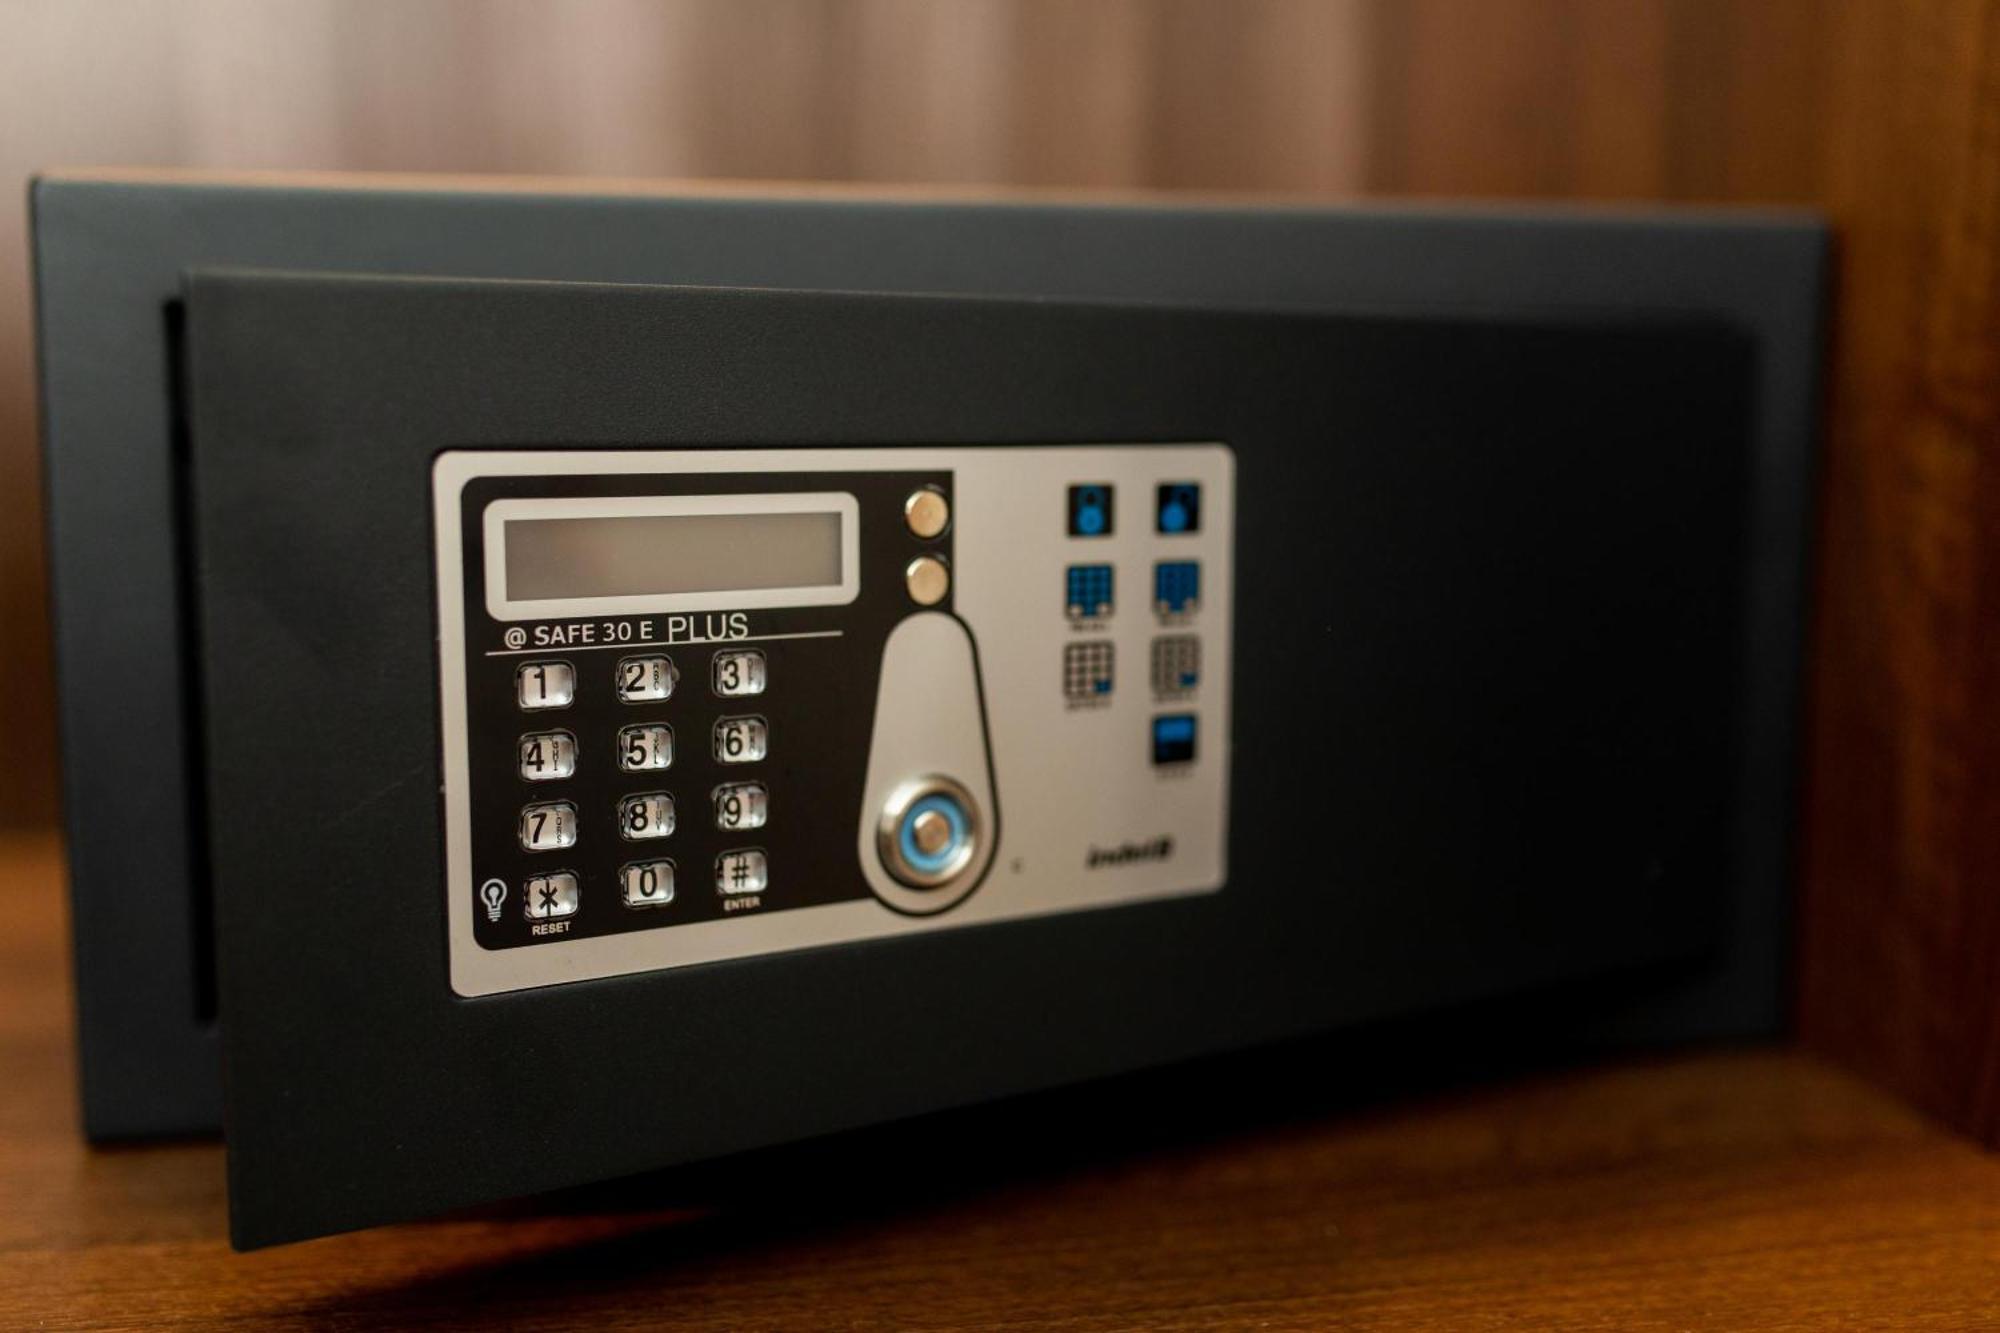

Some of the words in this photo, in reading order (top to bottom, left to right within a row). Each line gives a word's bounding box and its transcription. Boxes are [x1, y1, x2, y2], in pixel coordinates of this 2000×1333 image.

[504, 626, 527, 649] @
[534, 624, 595, 646] SAFE
[602, 622, 632, 642] 30
[640, 621, 653, 640] E
[668, 613, 749, 642] PLUS
[533, 667, 547, 700] 1
[626, 664, 646, 692] 2
[722, 660, 740, 689] 3
[627, 734, 647, 765] 5
[725, 727, 743, 756] 6
[527, 742, 545, 772] 4
[630, 803, 648, 831] 8
[724, 797, 741, 825] 9
[530, 813, 547, 844] 7
[640, 868, 657, 898] 0
[731, 856, 750, 888] #
[723, 896, 760, 911] ENTER
[532, 921, 571, 936] RESET
